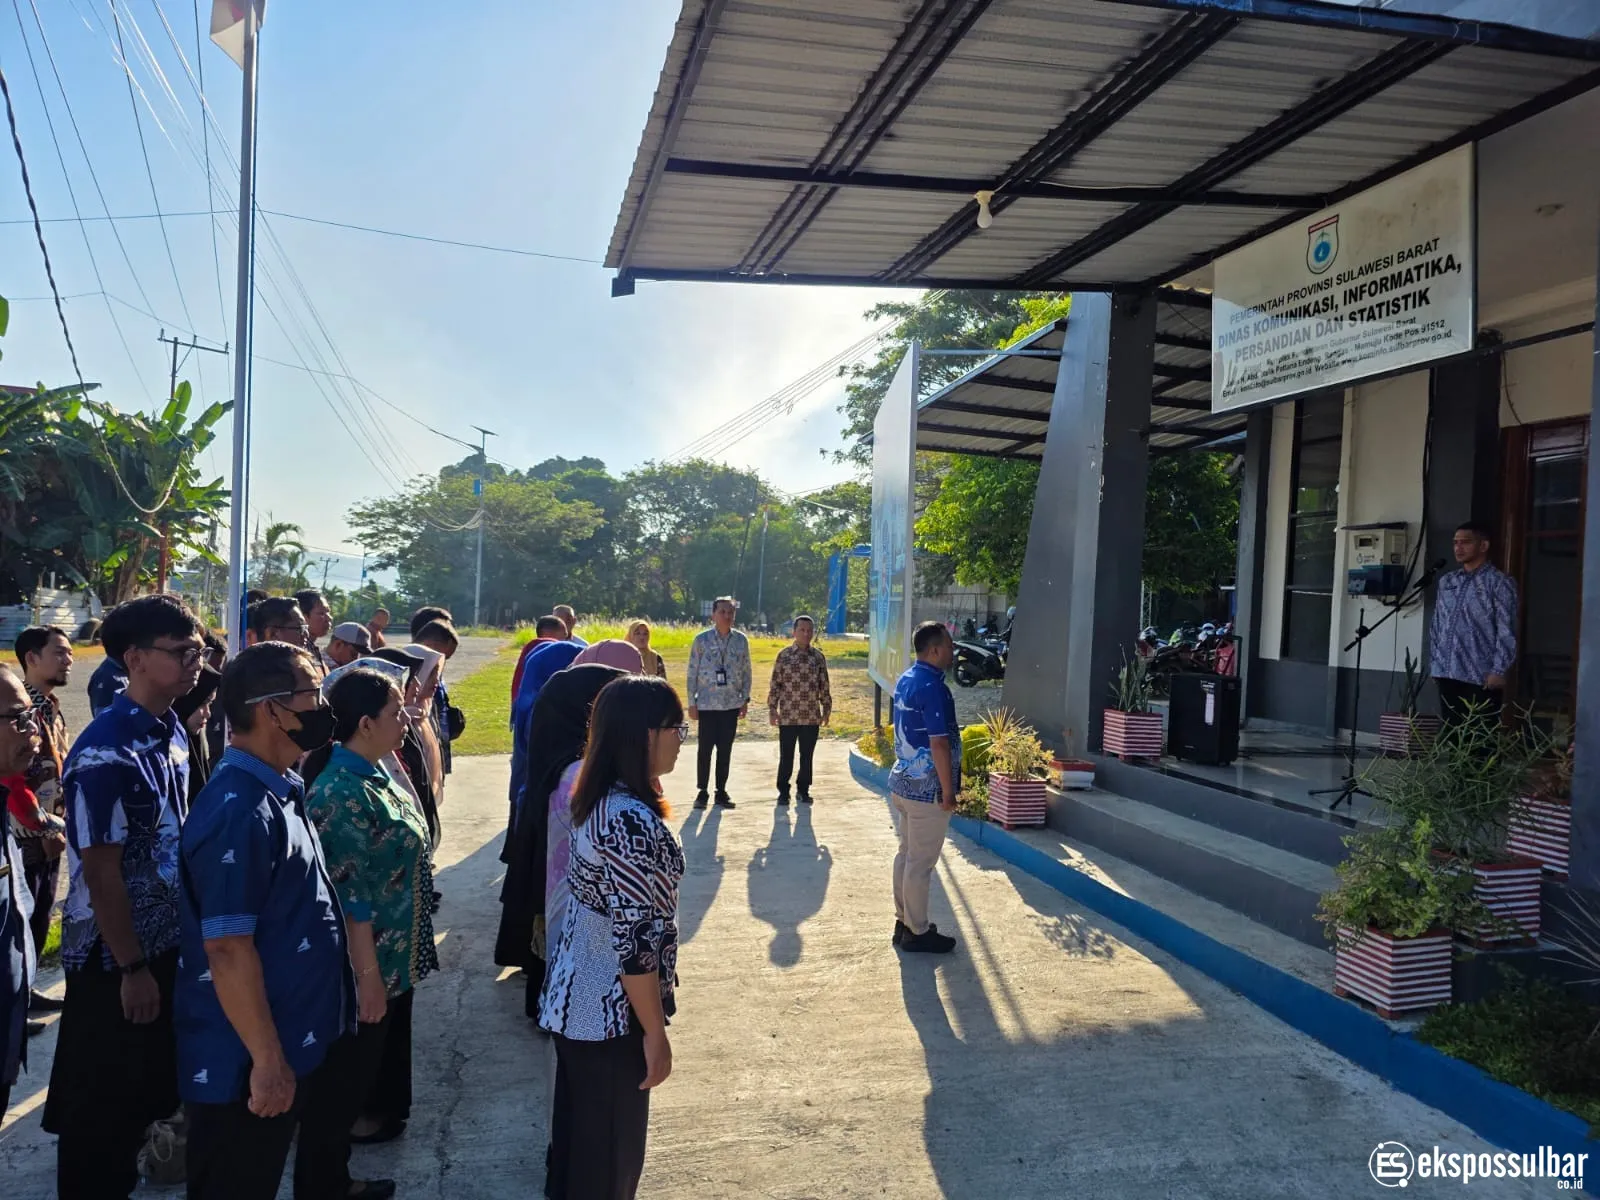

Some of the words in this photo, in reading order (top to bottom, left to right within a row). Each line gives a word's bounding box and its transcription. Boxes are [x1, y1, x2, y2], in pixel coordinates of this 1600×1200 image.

[1218, 326, 1250, 349] DINAS
[1253, 296, 1338, 338] KOMUNIKASI,
[1343, 253, 1462, 304] INFORMATIKA,
[1230, 296, 1285, 325] PEMERINTAH
[1287, 277, 1333, 302] PROVINSI
[1336, 255, 1394, 284] SULAWESI
[1397, 238, 1440, 264] BARAT
[1235, 326, 1313, 363] PERSANDIAN
[1316, 316, 1343, 338] DAN
[1348, 287, 1431, 326] STATISTIK
[1383, 330, 1402, 343] Kode
[1404, 326, 1418, 338] Pos
